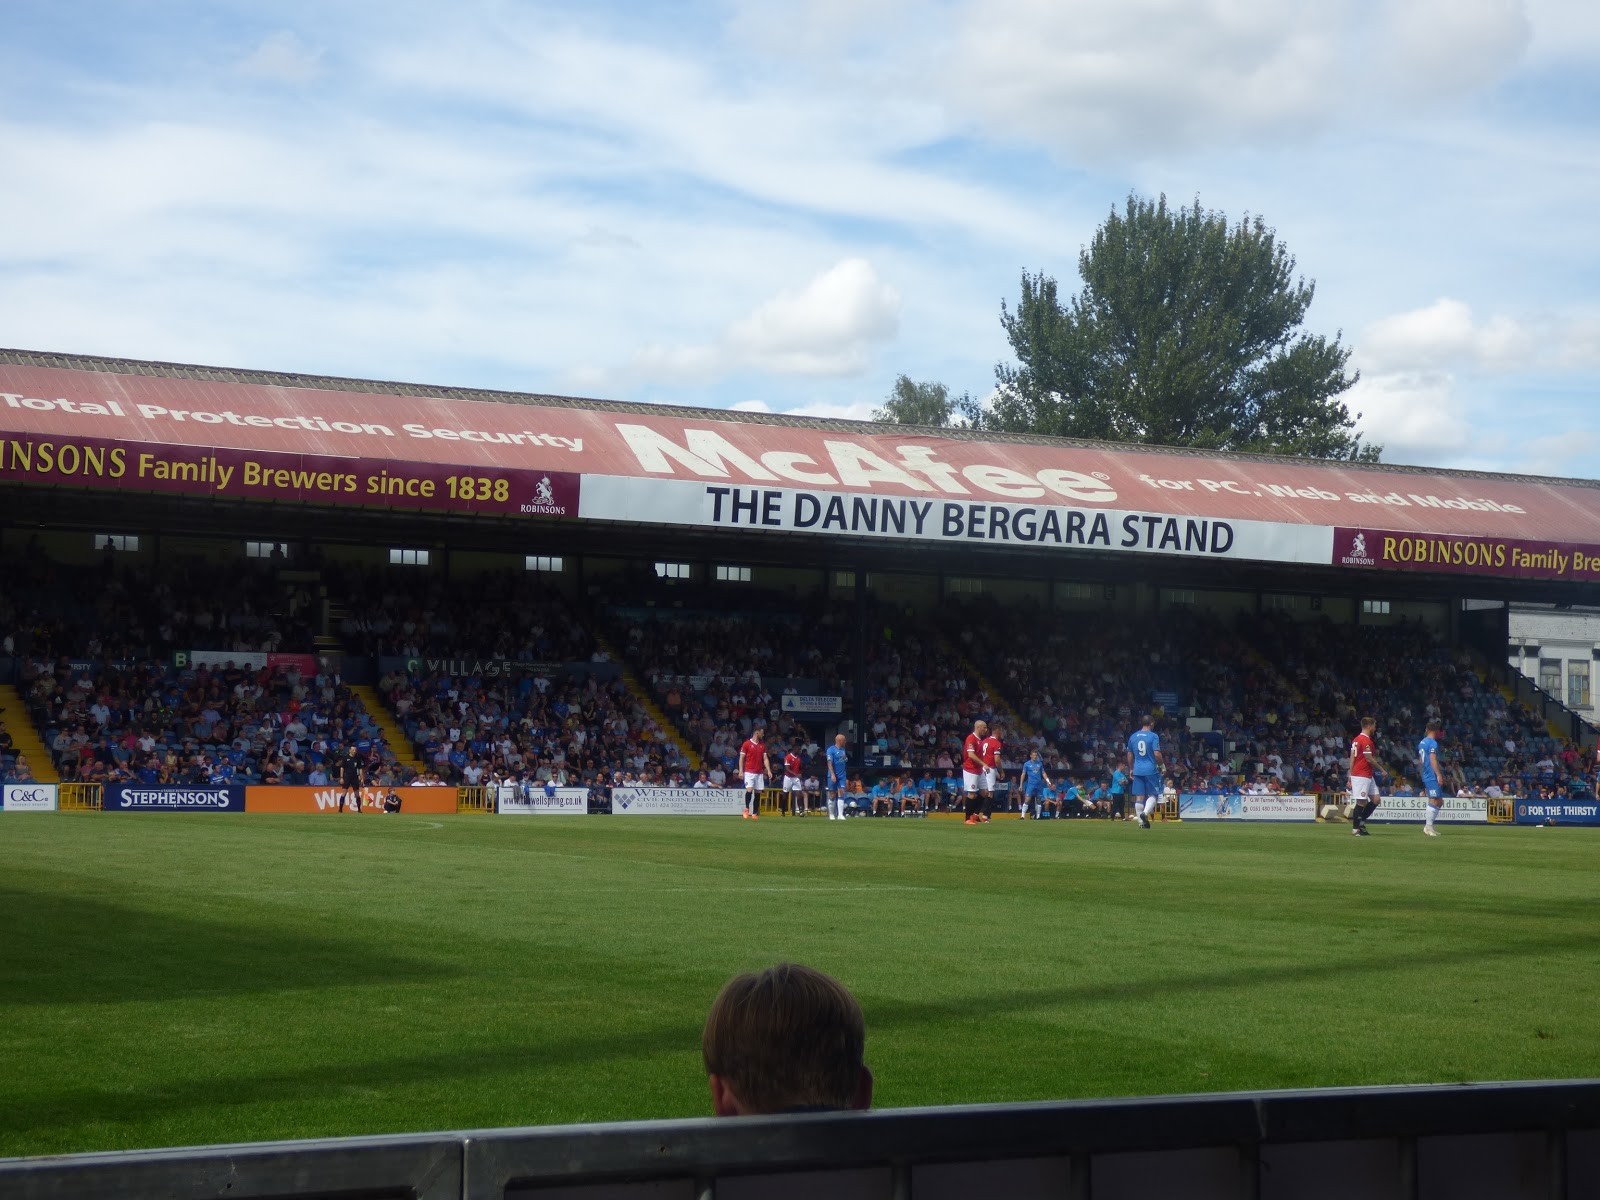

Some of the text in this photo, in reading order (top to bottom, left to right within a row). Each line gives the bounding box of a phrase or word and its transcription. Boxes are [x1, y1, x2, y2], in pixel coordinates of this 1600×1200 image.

[0, 393, 584, 452] Total Protection Security
[614, 423, 1118, 503] McAfee
[138, 453, 235, 490] Family
[243, 461, 357, 493] Brewers
[366, 470, 436, 497] since
[445, 475, 509, 501] 1838
[1139, 474, 1195, 491] for
[1257, 483, 1340, 501] Web
[1345, 489, 1412, 506] and
[1407, 493, 1526, 515] Mobile
[520, 504, 565, 515] ROBINSONS
[706, 486, 1235, 554] THE DANNY BERGARA STAND
[1341, 556, 1375, 566] ROBINSONS
[1382, 537, 1506, 567] ROBINSONS
[1511, 548, 1569, 574] Family
[175, 653, 187, 667] B
[407, 660, 418, 673] C
[427, 659, 511, 677] VILLAGE
[1137, 740, 1147, 756] 9
[10, 789, 44, 802] C&C
[120, 788, 230, 808] STEPHENSONS
[634, 789, 734, 798] WESTBOURNE
[1471, 800, 1487, 809] Ltd
[1528, 806, 1597, 816] FOR THE THIRSTY
